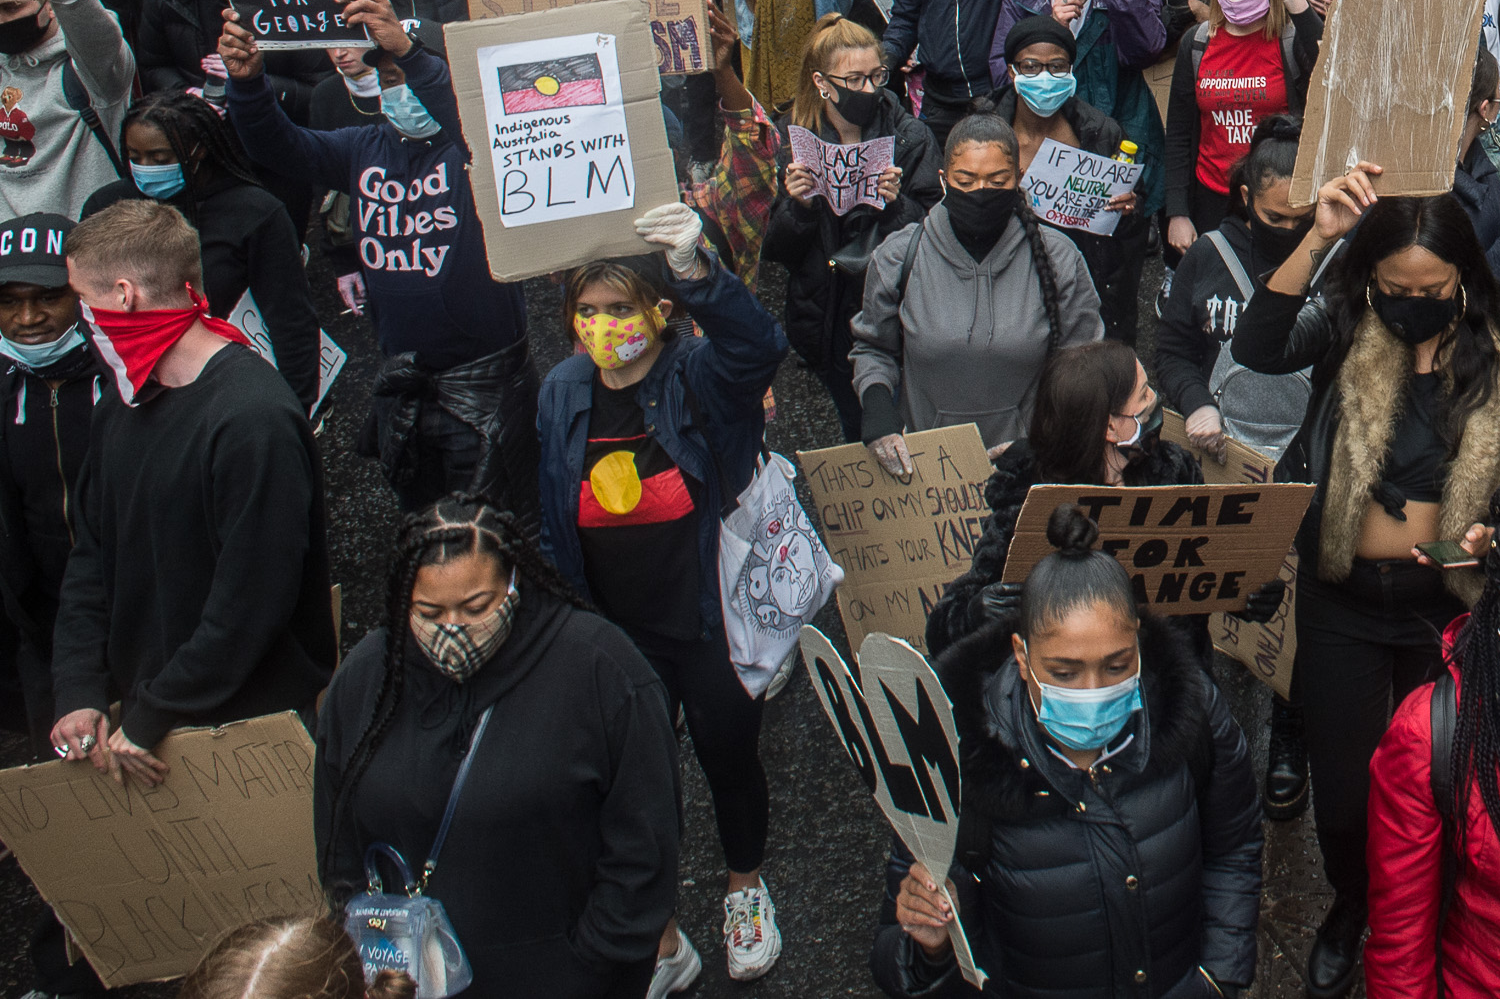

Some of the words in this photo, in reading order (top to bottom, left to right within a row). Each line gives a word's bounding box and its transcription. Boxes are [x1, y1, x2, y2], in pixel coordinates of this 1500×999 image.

[1200, 76, 1267, 90] OPPORTUNITIES
[494, 113, 571, 136] Indigenous
[1211, 109, 1253, 126] MADE
[492, 129, 562, 150] Australia
[502, 140, 577, 168] STANDS
[580, 132, 627, 154] WITH
[814, 138, 870, 169] BLACK
[1048, 146, 1071, 168] IF
[1072, 153, 1104, 178] YOU
[1101, 163, 1138, 184] ARE
[358, 163, 451, 203] Good
[500, 154, 632, 216] BLM
[1027, 175, 1059, 200] YOU
[1056, 190, 1087, 207] ARE
[1063, 174, 1113, 198] NEUTRAL
[358, 201, 458, 238] Vibes
[1053, 201, 1081, 217] WITH
[1082, 208, 1099, 220] THE
[358, 236, 450, 279] Only
[811, 460, 875, 493] THATS
[937, 445, 963, 482] A
[822, 499, 865, 532] CHIP
[872, 497, 898, 521] ON
[896, 490, 926, 518] MY
[1077, 492, 1261, 527] TIME
[835, 543, 890, 573] THATS
[895, 538, 936, 566] YOUR
[1102, 536, 1210, 569] FOR
[850, 598, 876, 622] ON
[885, 588, 912, 615] MY
[815, 656, 961, 825] BLM
[180, 738, 314, 800] MATTER
[109, 820, 276, 886] UNTIL
